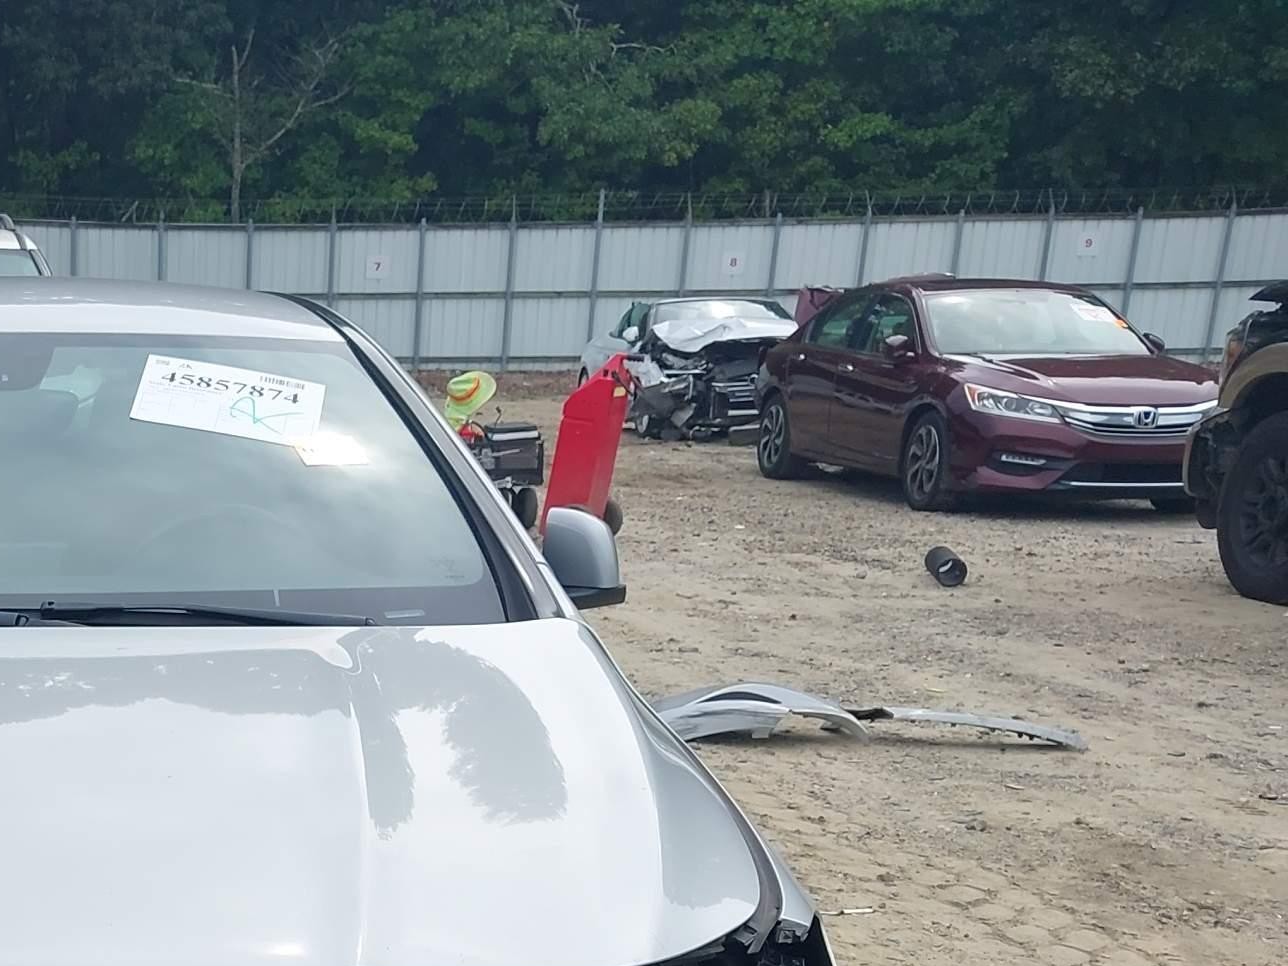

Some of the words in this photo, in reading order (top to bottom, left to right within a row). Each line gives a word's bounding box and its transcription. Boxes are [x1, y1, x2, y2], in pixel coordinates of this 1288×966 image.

[1085, 238, 1093, 248] 9
[372, 261, 382, 272] 7
[161, 372, 300, 405] 45857874
